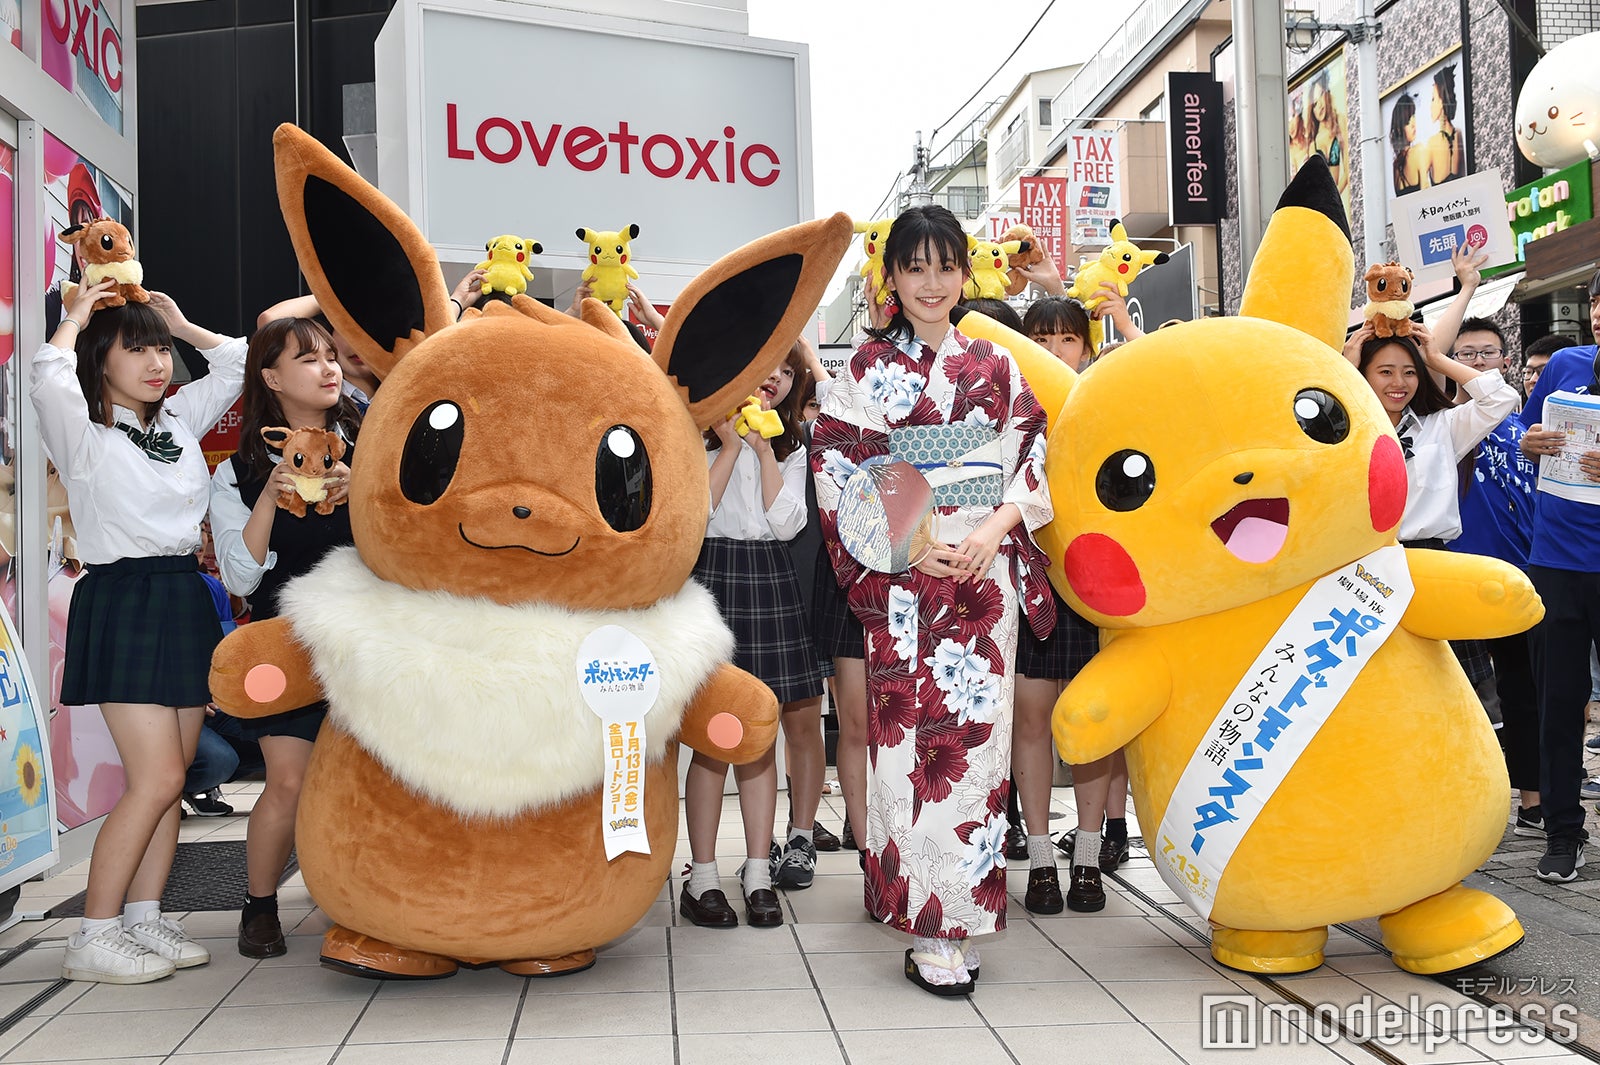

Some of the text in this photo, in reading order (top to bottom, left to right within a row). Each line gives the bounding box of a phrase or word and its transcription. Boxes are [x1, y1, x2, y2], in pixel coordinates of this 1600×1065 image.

[446, 103, 781, 187] Lovetoxic
[1072, 136, 1113, 162] TAX
[1184, 93, 1208, 203] aimerfeel
[1073, 162, 1114, 184] FREE
[1023, 183, 1061, 207] TAX
[1023, 207, 1061, 227] FREE
[1418, 197, 1470, 221] 本日のイベント
[1429, 232, 1458, 254] 先頭
[1336, 574, 1386, 616] 劇場版
[584, 659, 655, 685] ポケットモンスター
[599, 683, 645, 693] みんなの物語
[1204, 642, 1296, 766] みんなの物語
[1190, 607, 1386, 856] ポケットモンスター
[608, 722, 624, 815] 全国ロードショー
